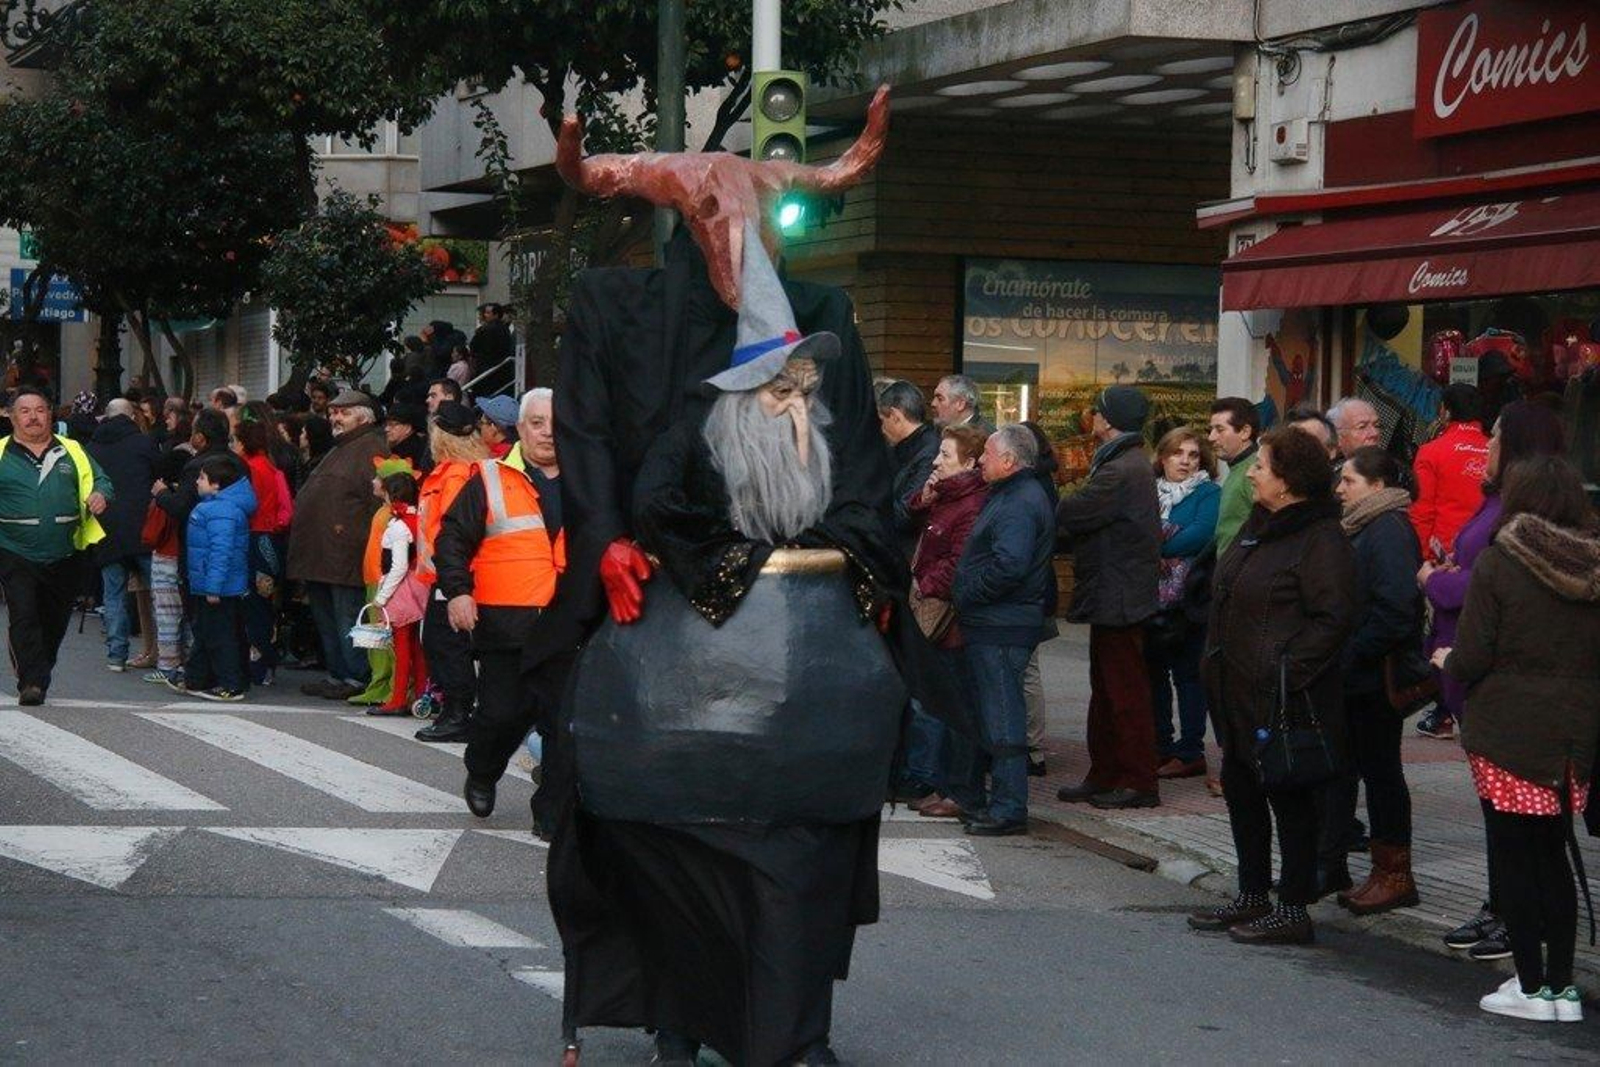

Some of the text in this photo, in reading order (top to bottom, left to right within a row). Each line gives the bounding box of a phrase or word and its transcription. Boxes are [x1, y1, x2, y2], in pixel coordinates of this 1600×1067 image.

[1434, 13, 1589, 119] Comics
[983, 270, 1093, 299] Enamórate
[1408, 261, 1469, 294] Comics
[1023, 302, 1042, 318] de
[1047, 304, 1089, 319] hacer
[1092, 305, 1106, 320] la
